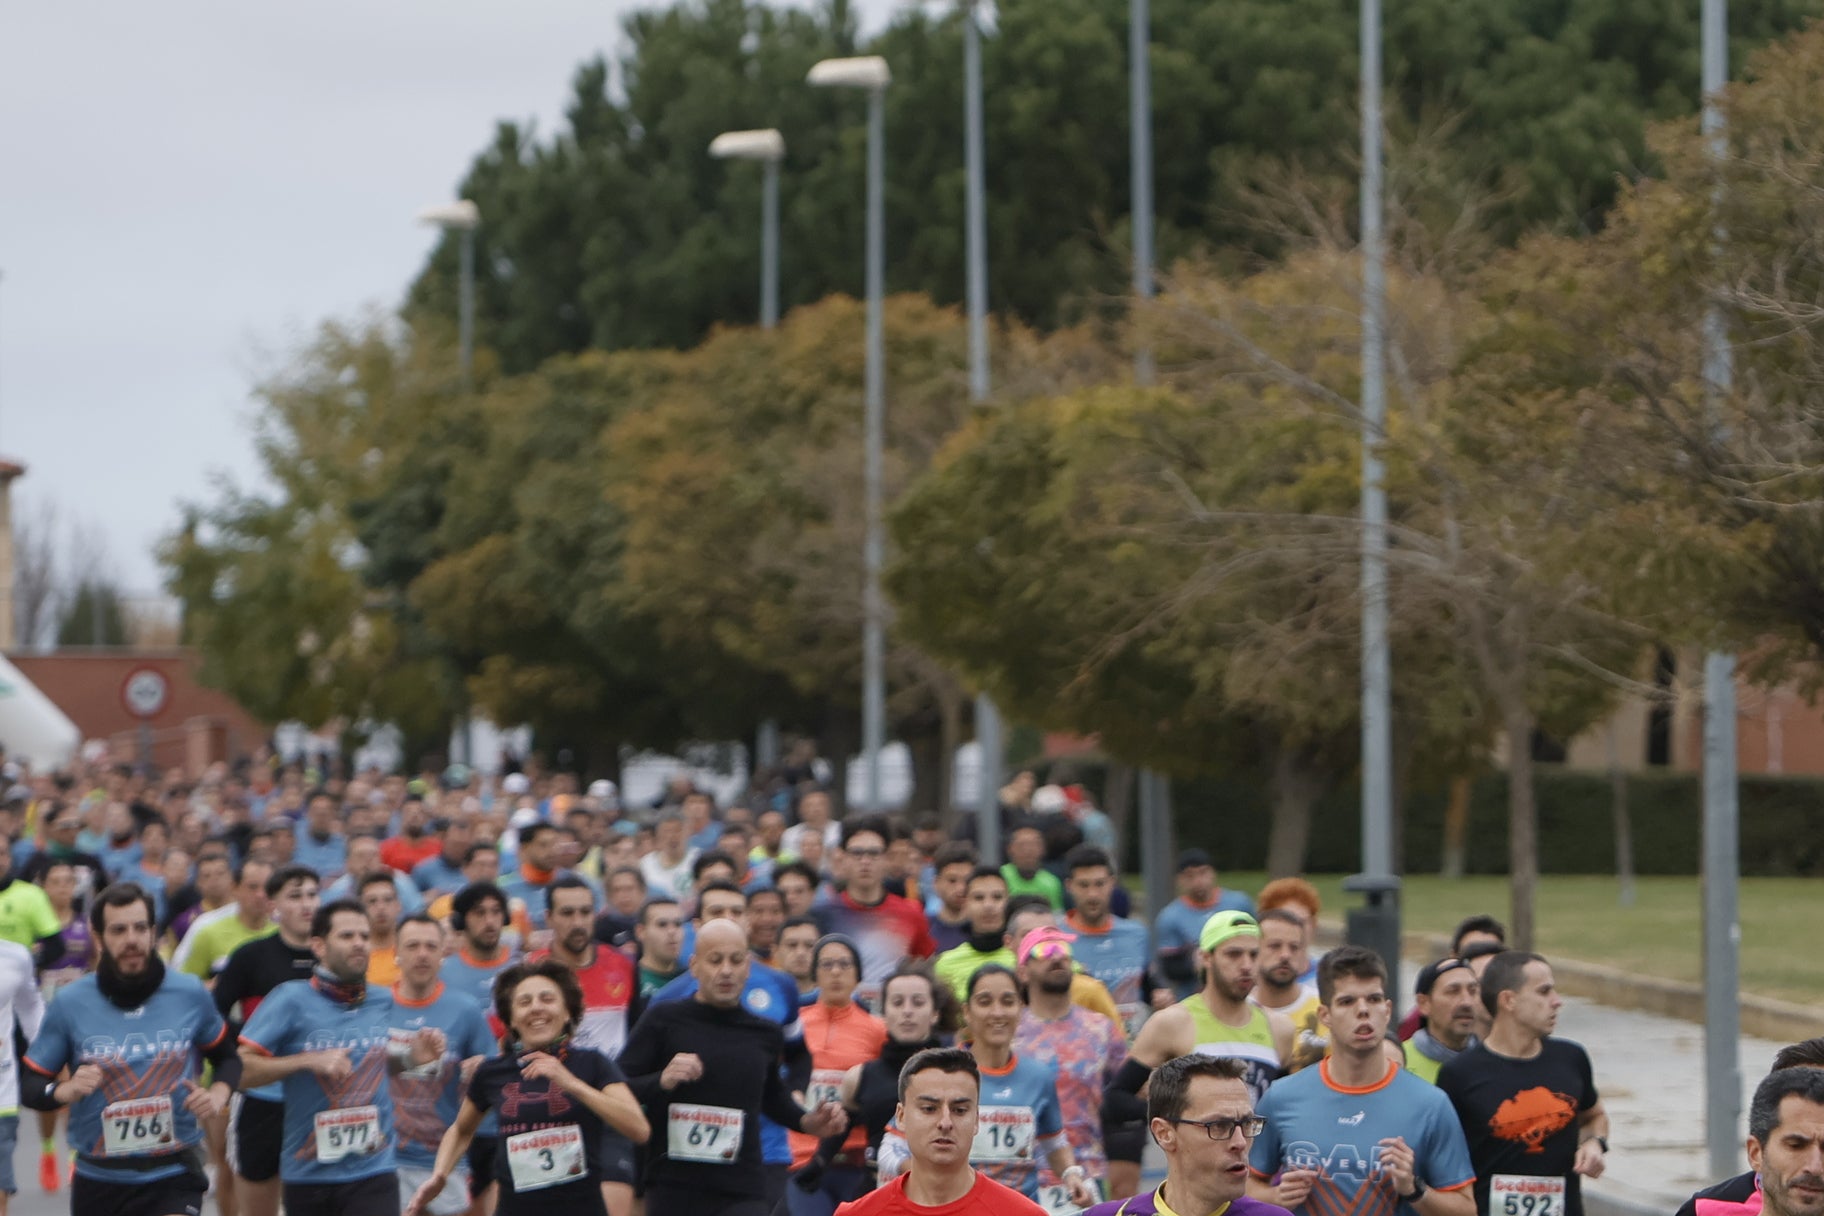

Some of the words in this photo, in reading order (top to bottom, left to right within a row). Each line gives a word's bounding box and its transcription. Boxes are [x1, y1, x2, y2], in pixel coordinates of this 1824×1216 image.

[115, 1115, 162, 1140] 766
[328, 1124, 370, 1147] 577
[687, 1124, 720, 1147] 67
[989, 1125, 1016, 1147] 16
[538, 1147, 555, 1171] 3
